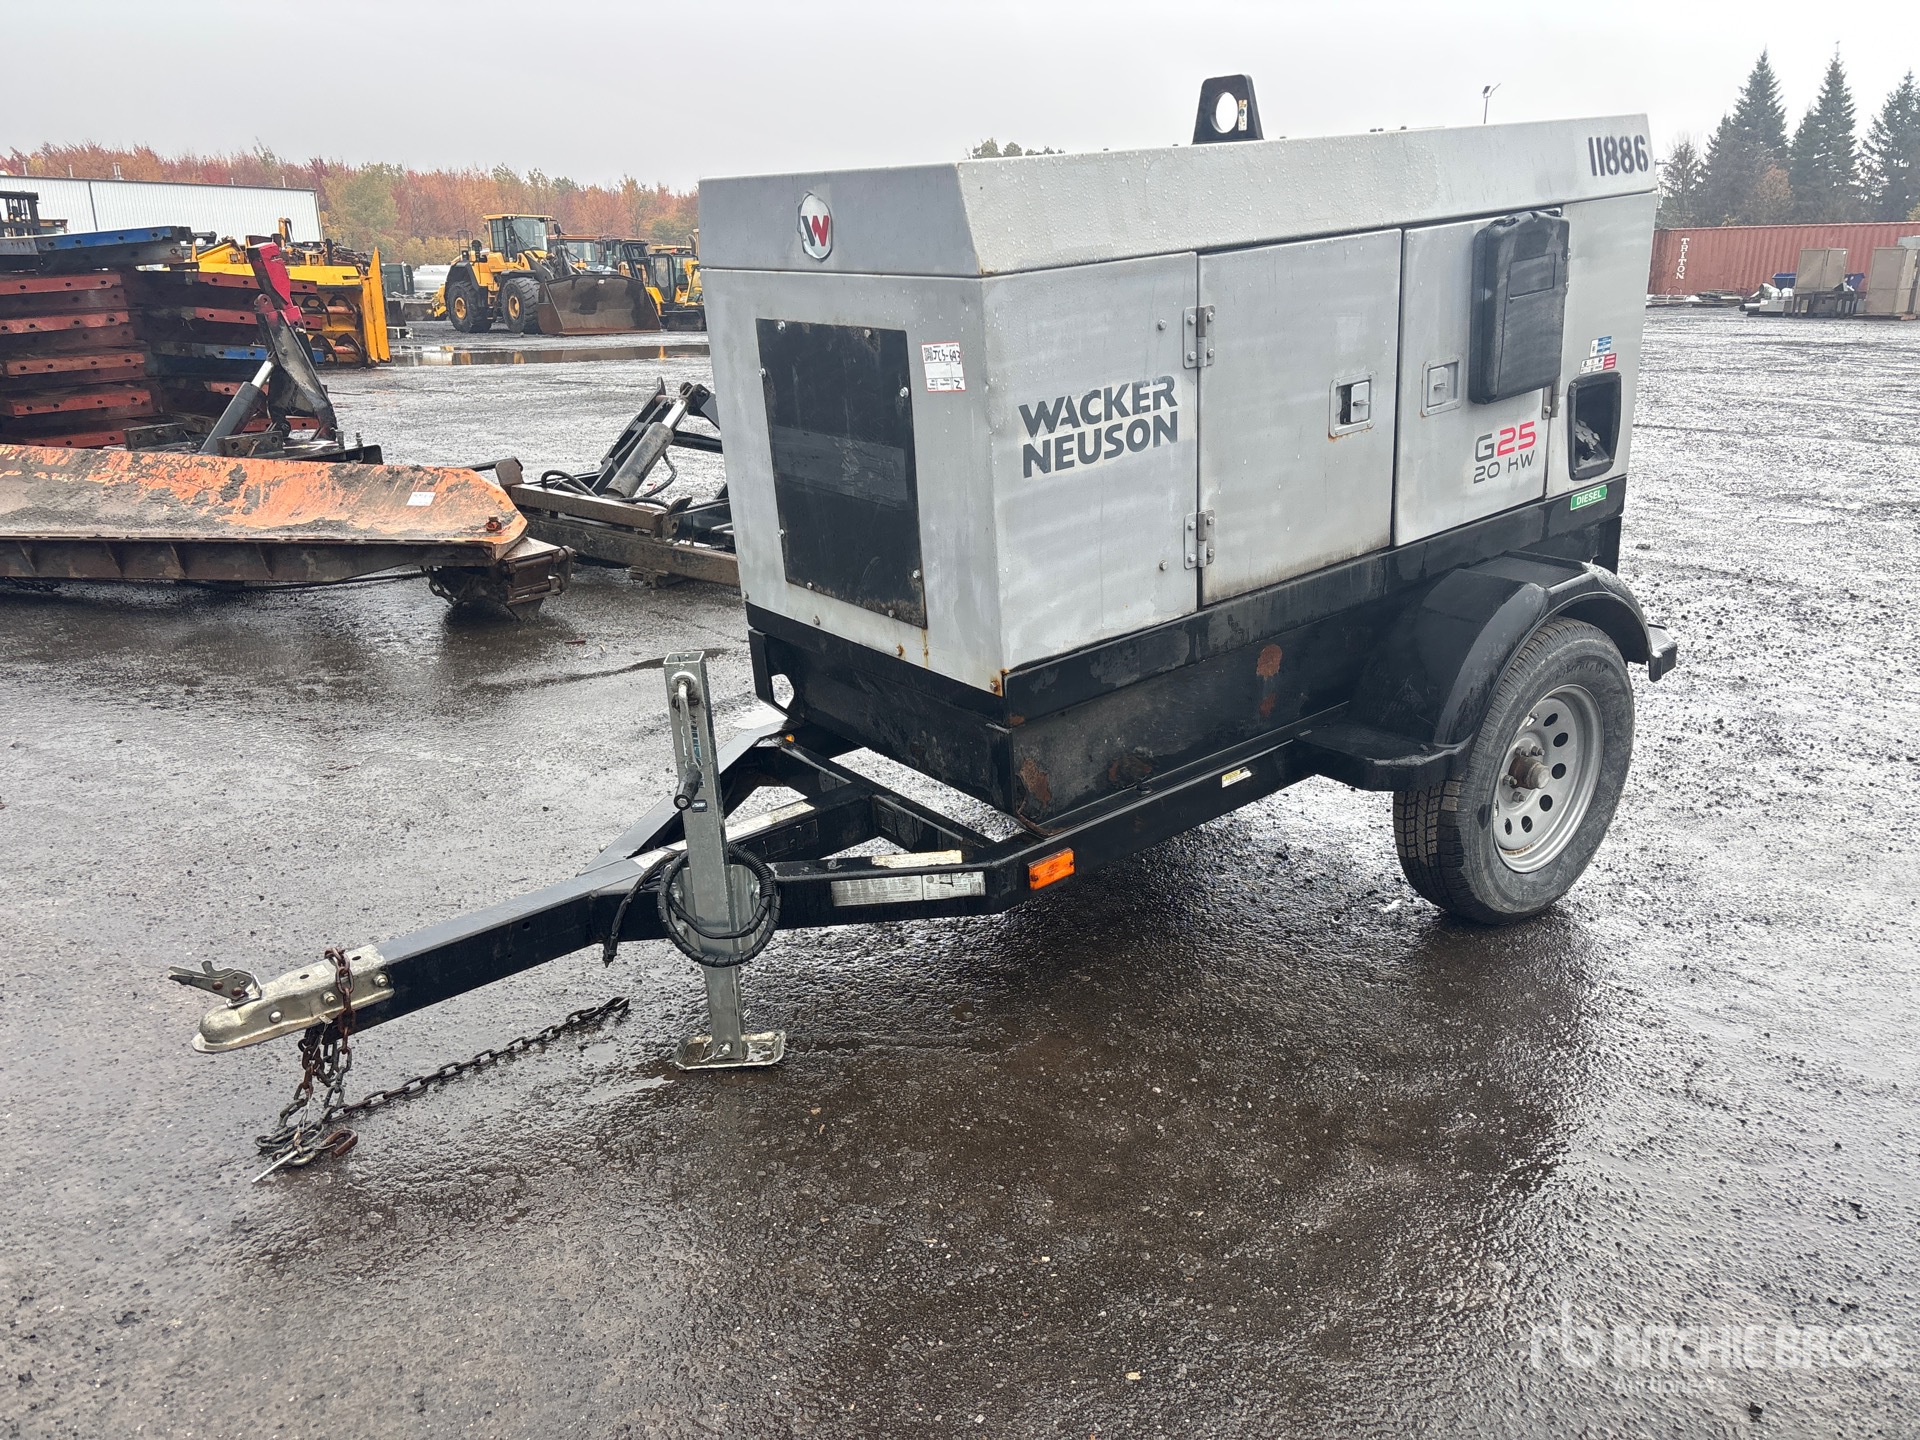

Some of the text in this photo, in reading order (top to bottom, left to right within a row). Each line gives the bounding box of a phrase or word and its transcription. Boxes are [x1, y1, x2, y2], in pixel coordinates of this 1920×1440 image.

[1588, 134, 1649, 176] 11886
[801, 215, 830, 247] W
[1675, 237, 1690, 280] TRITON
[1018, 375, 1178, 438] WACKER
[1023, 411, 1178, 478] NEUSON
[1475, 421, 1537, 462] G25
[1473, 461, 1501, 484] 20
[1576, 490, 1602, 505] DIESEL
